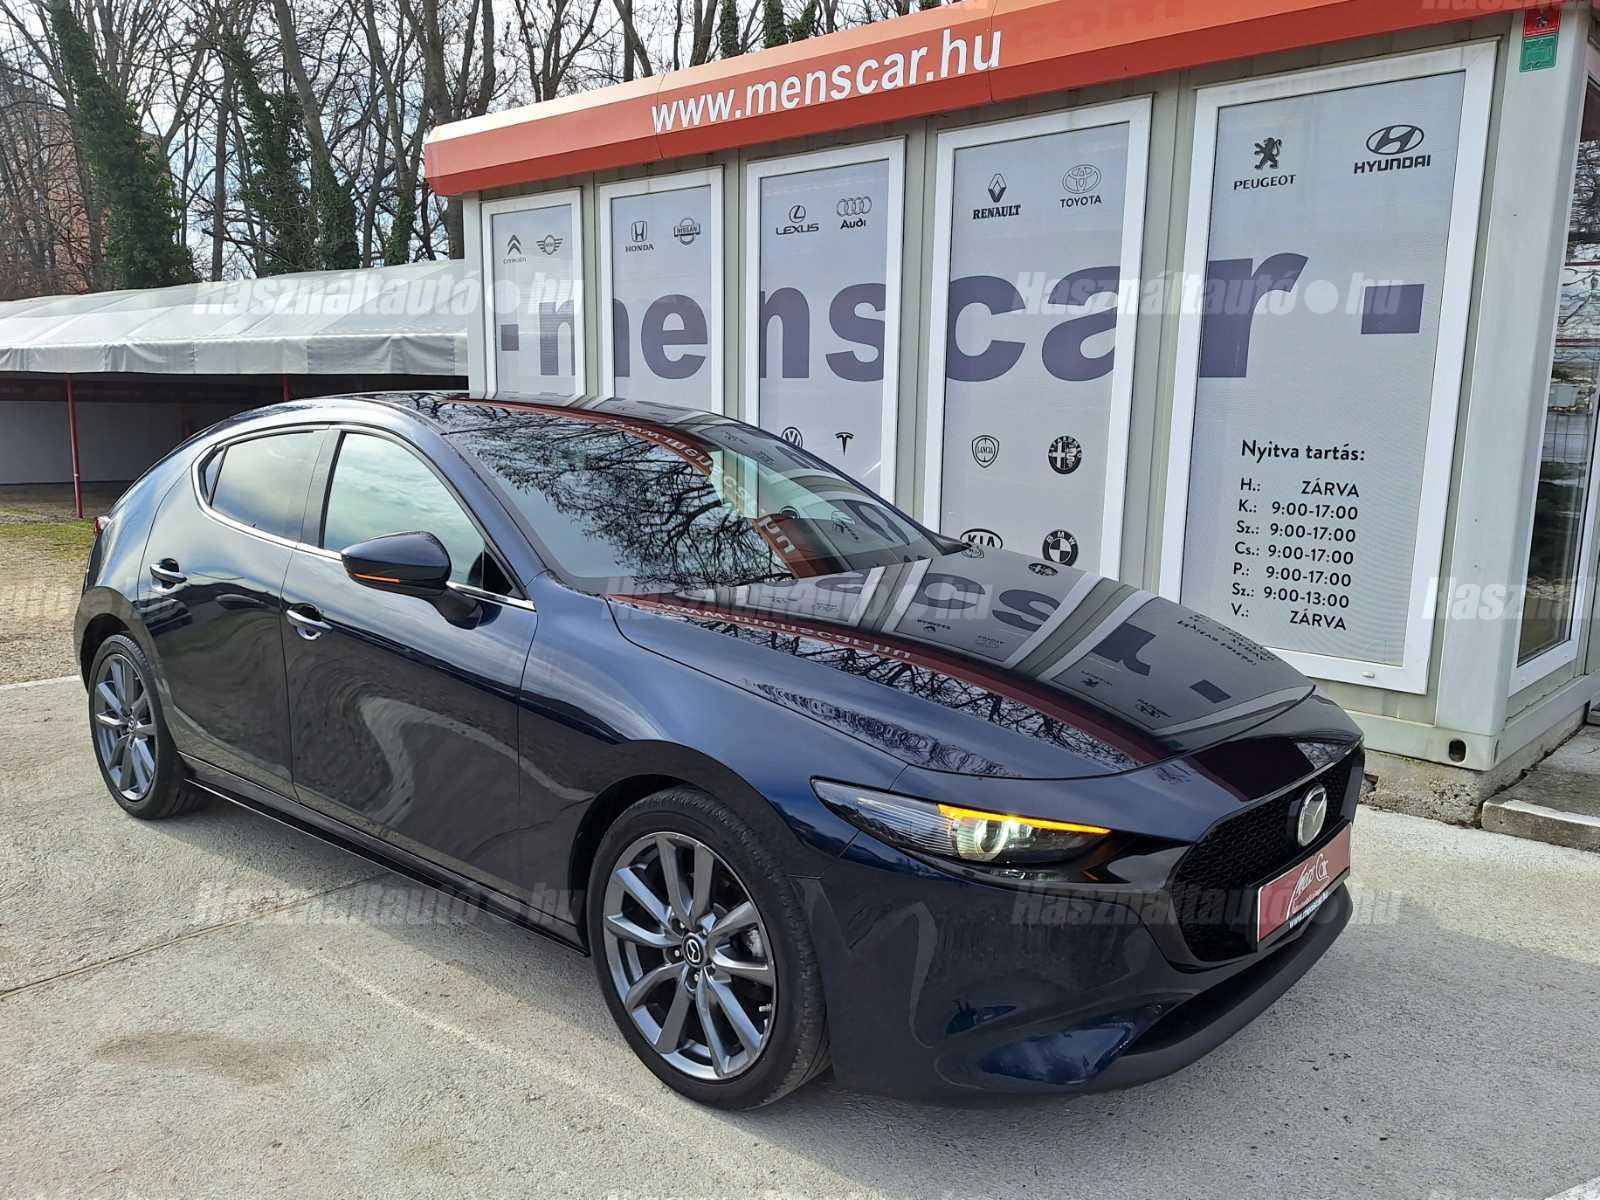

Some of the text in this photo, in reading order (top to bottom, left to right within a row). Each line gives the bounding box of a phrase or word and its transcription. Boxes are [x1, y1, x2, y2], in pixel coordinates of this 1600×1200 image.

[651, 29, 1001, 133] www.menscar.hu
[1353, 154, 1431, 174] HYUNDAI
[1233, 174, 1297, 190] PEUGEOT
[1059, 195, 1103, 208] TOYOTA
[972, 204, 1022, 220] RENAULT
[775, 223, 820, 235] LEXUS
[840, 218, 867, 229] Audi
[625, 243, 655, 253] HONDA
[1241, 440, 1365, 463] Nyitva tartás:
[1240, 478, 1359, 498] H.: ZÁRVA
[1238, 499, 1358, 520] K.: 9:00-17:00
[1236, 520, 1356, 542] Sz.: 9:00-17:00
[1234, 541, 1354, 565] Cs.: 9:00-17:00
[1233, 562, 1351, 587] P.: 9:00-17:00
[1232, 582, 1350, 608] Sz.: 9:00-13:00
[1231, 603, 1347, 631] V.: ZÁRVA
